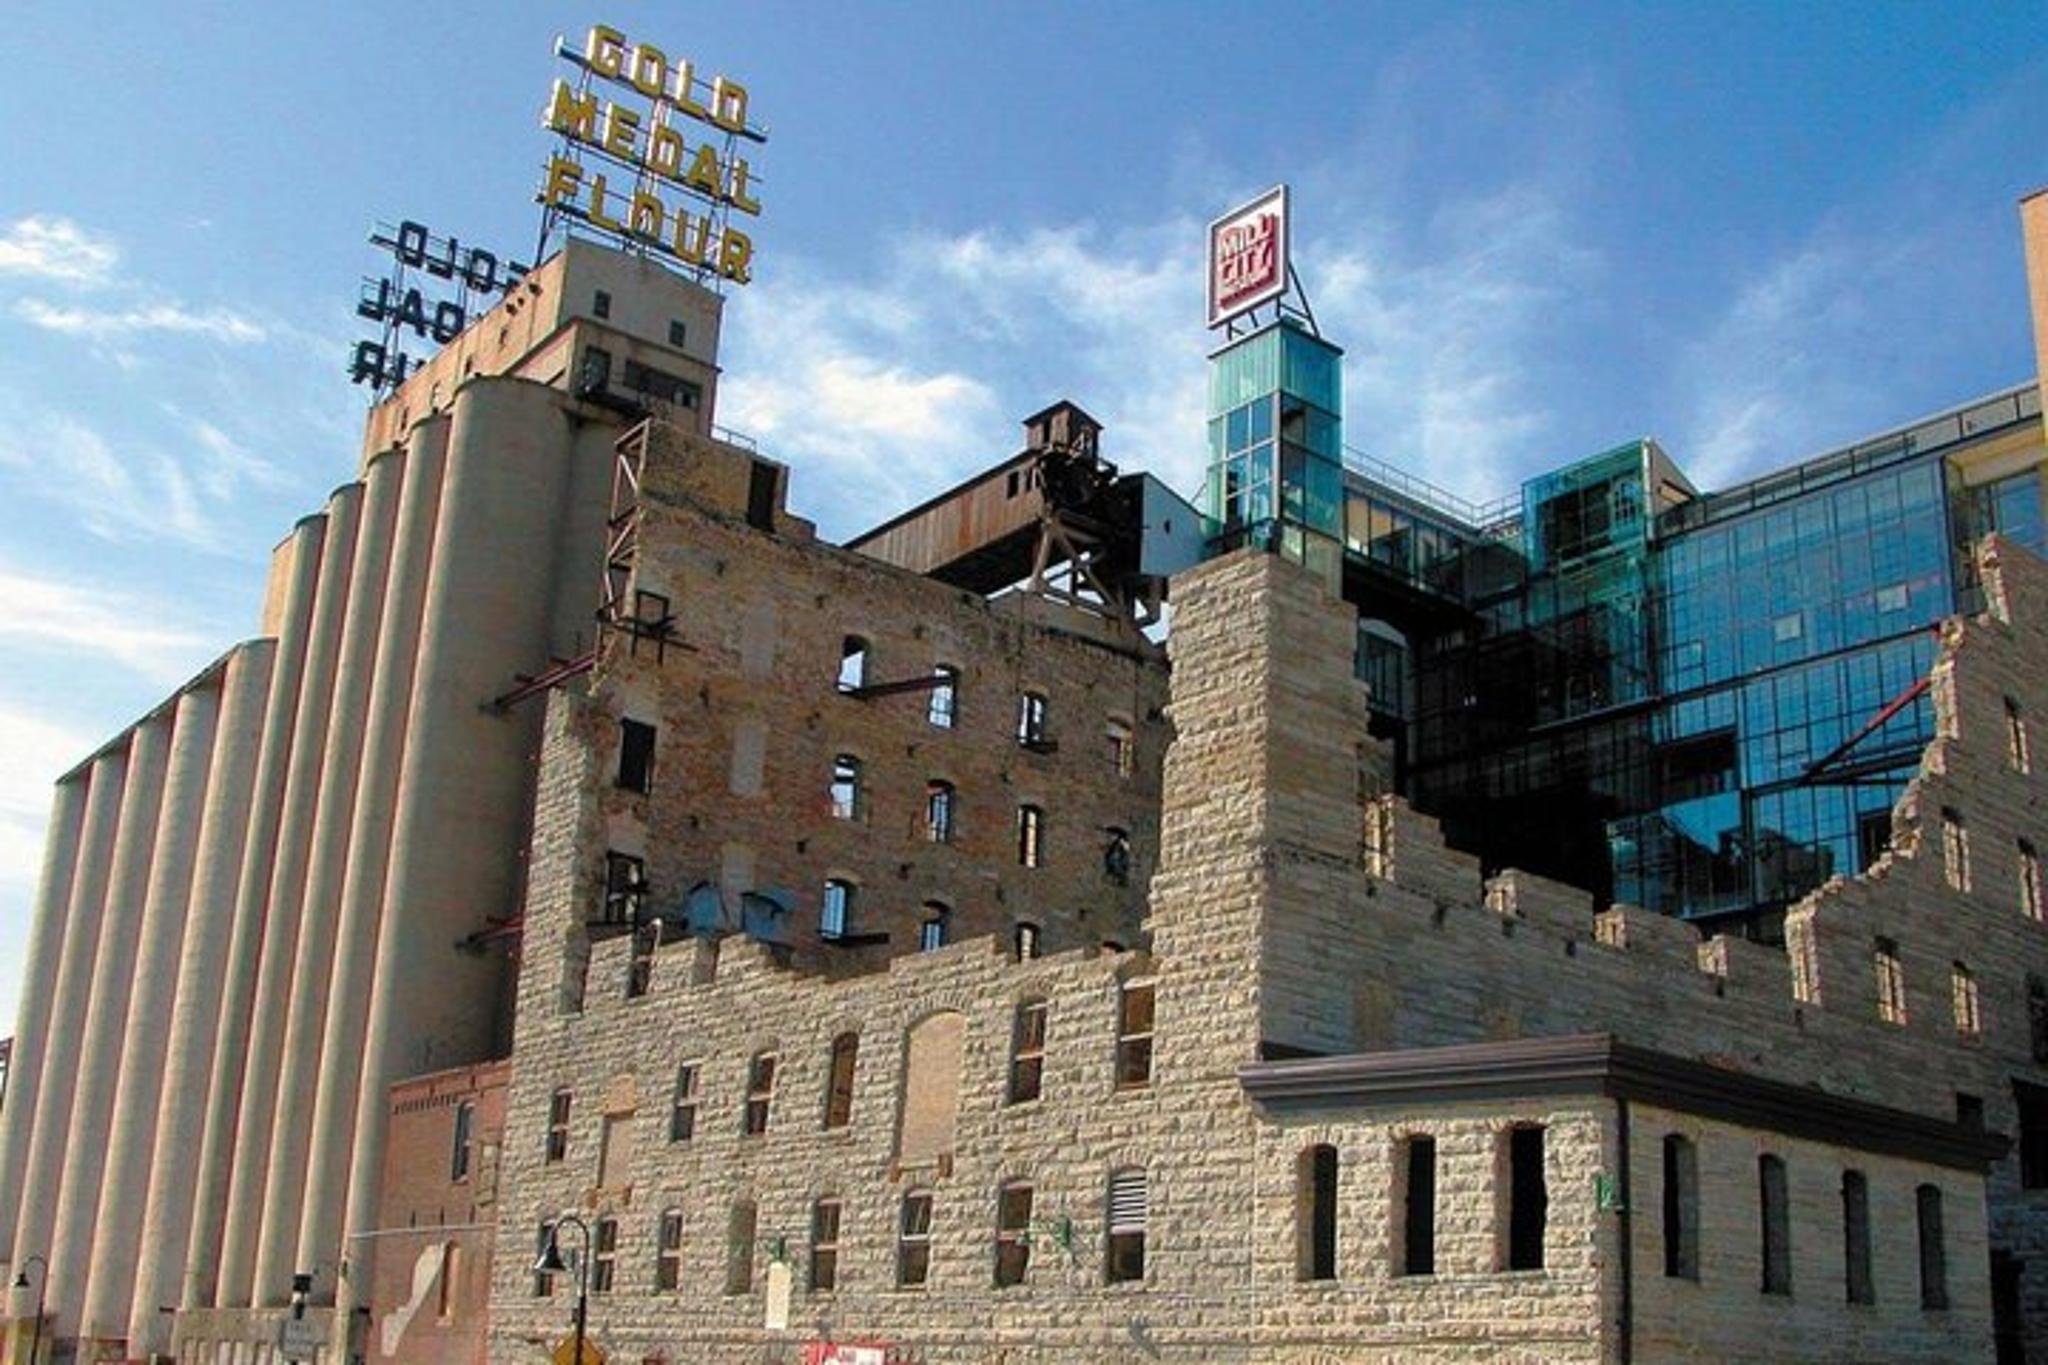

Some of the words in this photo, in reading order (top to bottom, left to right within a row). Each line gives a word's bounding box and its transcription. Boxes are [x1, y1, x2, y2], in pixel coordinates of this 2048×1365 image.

[584, 24, 748, 133] GOLD
[550, 78, 761, 217] MEDAL
[546, 154, 752, 285] FLOUR
[1218, 239, 1274, 284] CITY
